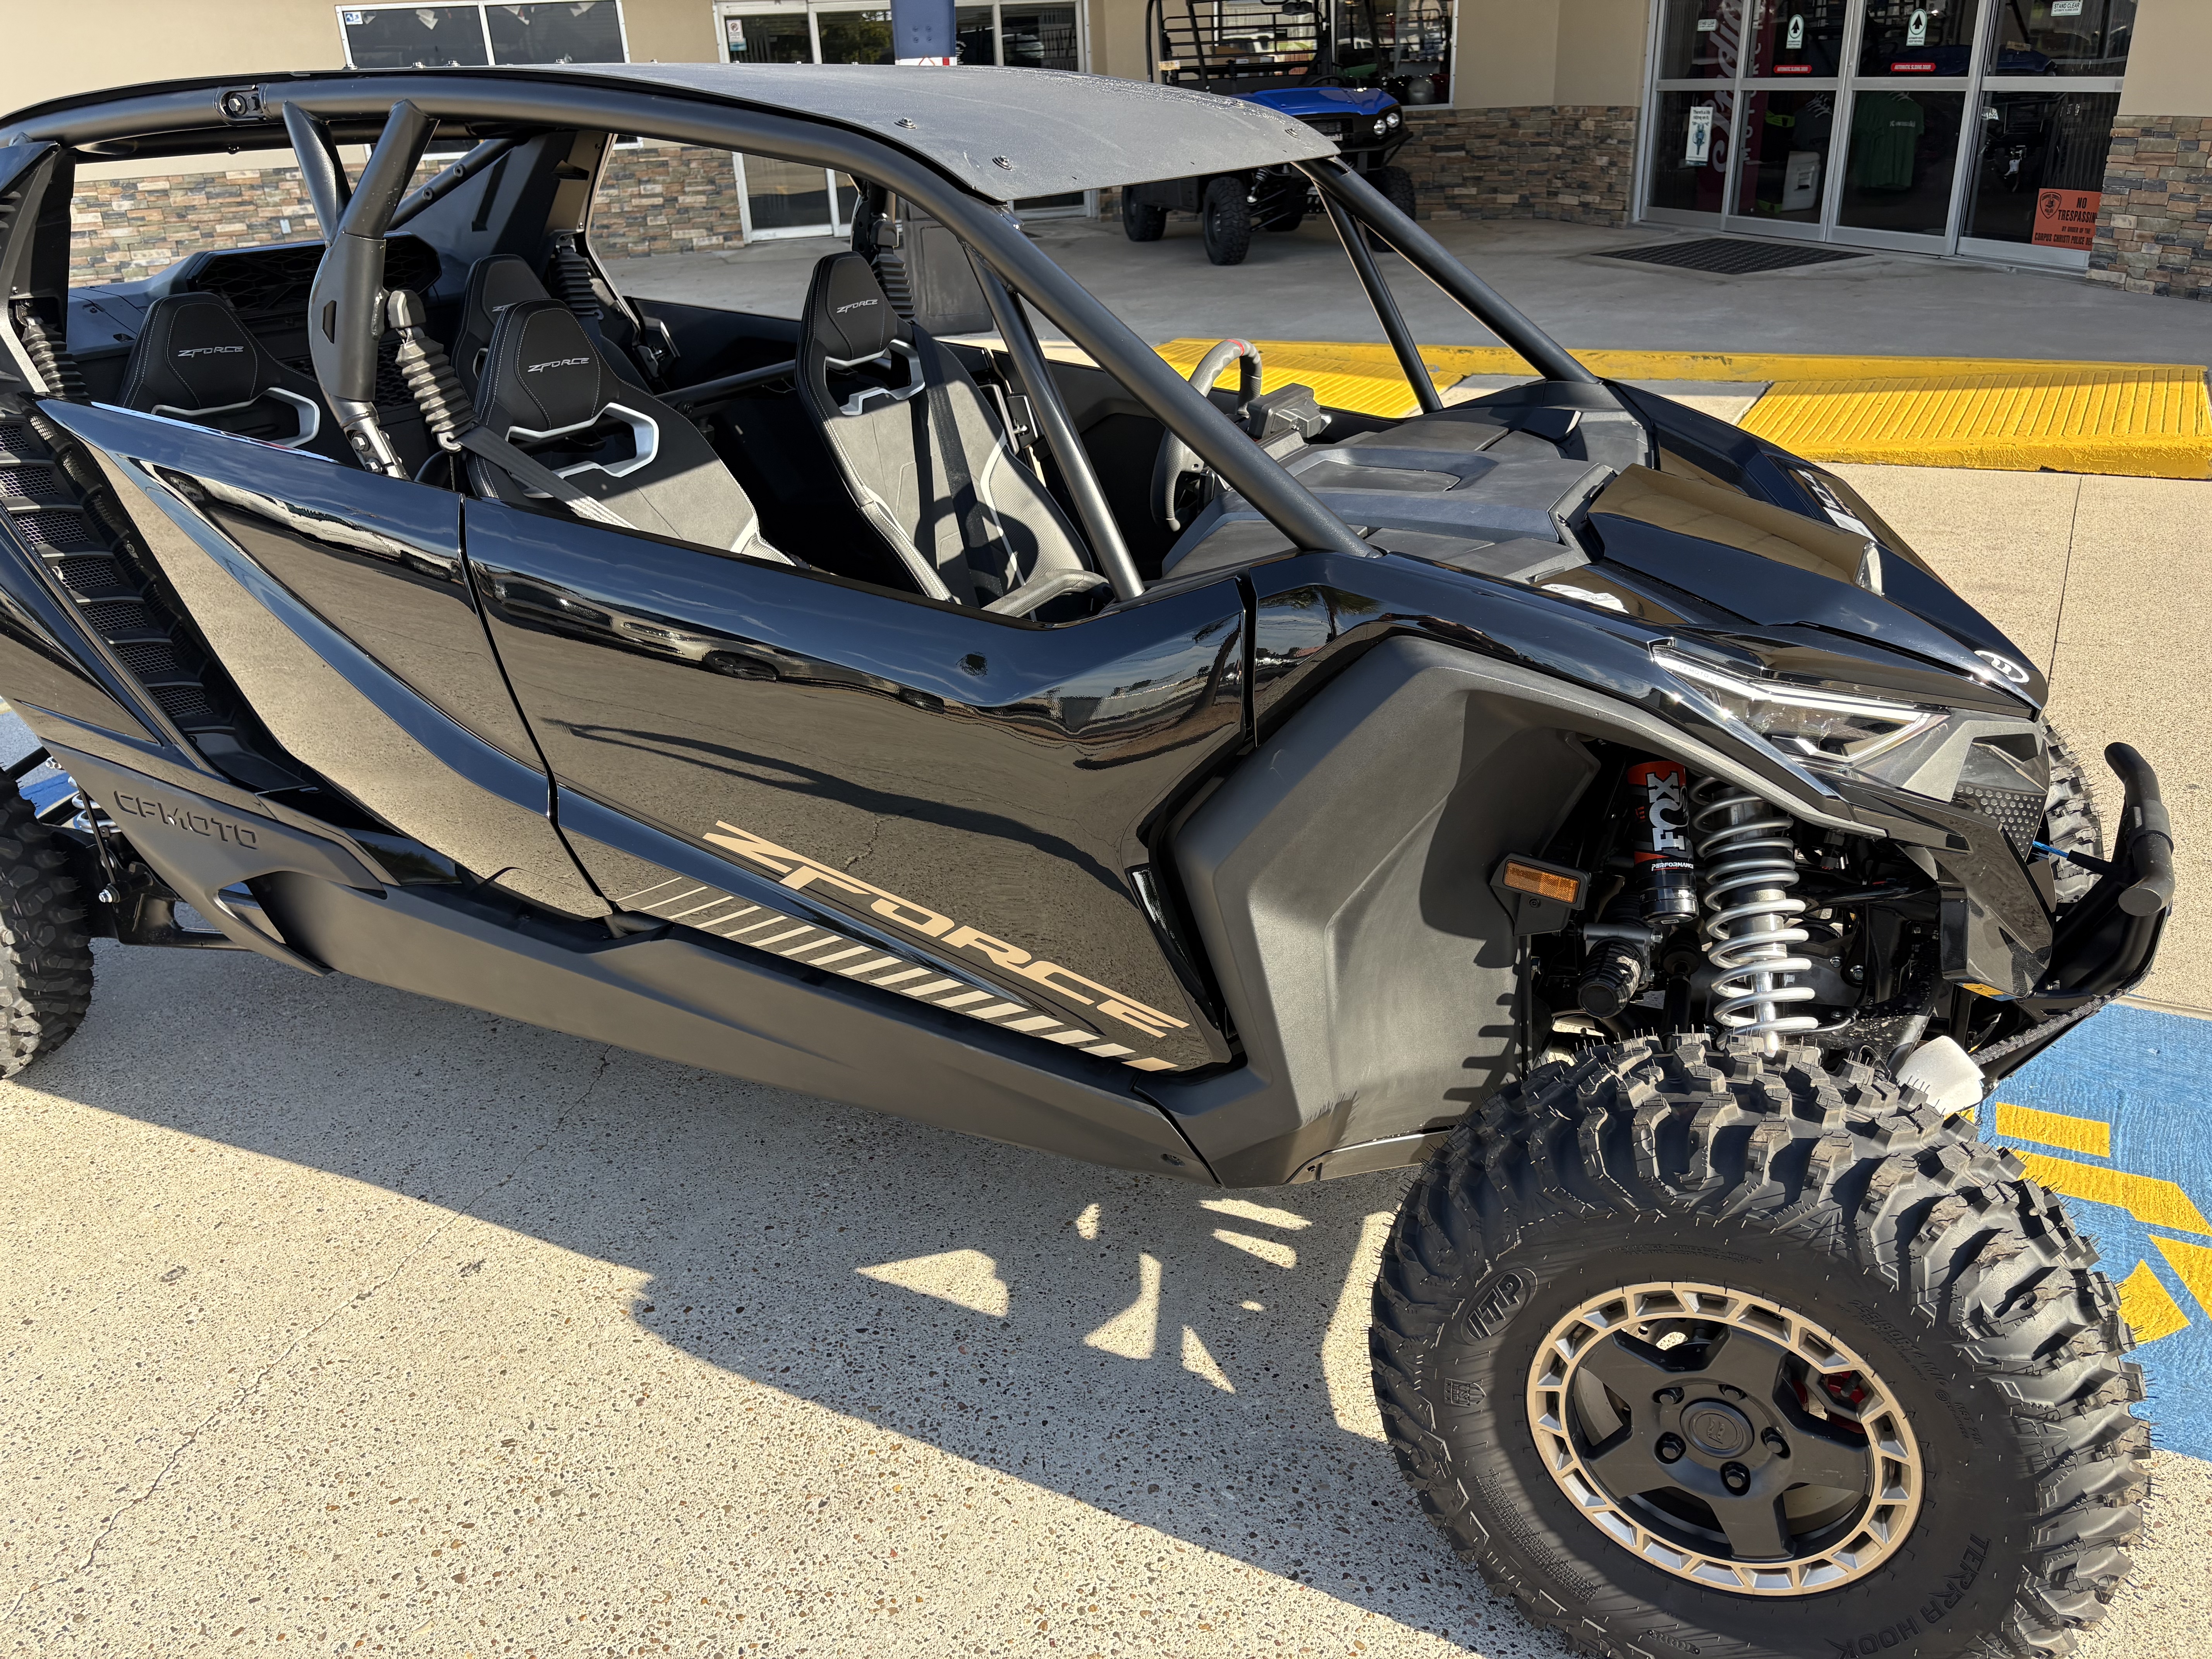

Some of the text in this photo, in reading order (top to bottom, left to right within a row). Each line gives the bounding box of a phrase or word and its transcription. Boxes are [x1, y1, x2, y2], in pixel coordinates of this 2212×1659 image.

[2076, 197, 2087, 209] NO
[2058, 209, 2098, 223] TRESPASSIN
[2035, 232, 2052, 242] CORPUS
[2053, 234, 2070, 243] CHRISTI
[2071, 236, 2085, 245] POLICE
[836, 299, 878, 314] ZFORCE
[177, 345, 244, 358] ZFORCE
[527, 357, 590, 373] ZFORCE
[1679, 664, 1709, 678] CFMOTO
[1647, 772, 1689, 852] FOX
[113, 790, 259, 850] CFMOTO
[1651, 862, 1694, 872] PERFORMANCE
[702, 819, 1190, 1038] ZFORCE
[1467, 1272, 1524, 1340] ITP
[1823, 1533, 1992, 1659] TERRA HOOK
